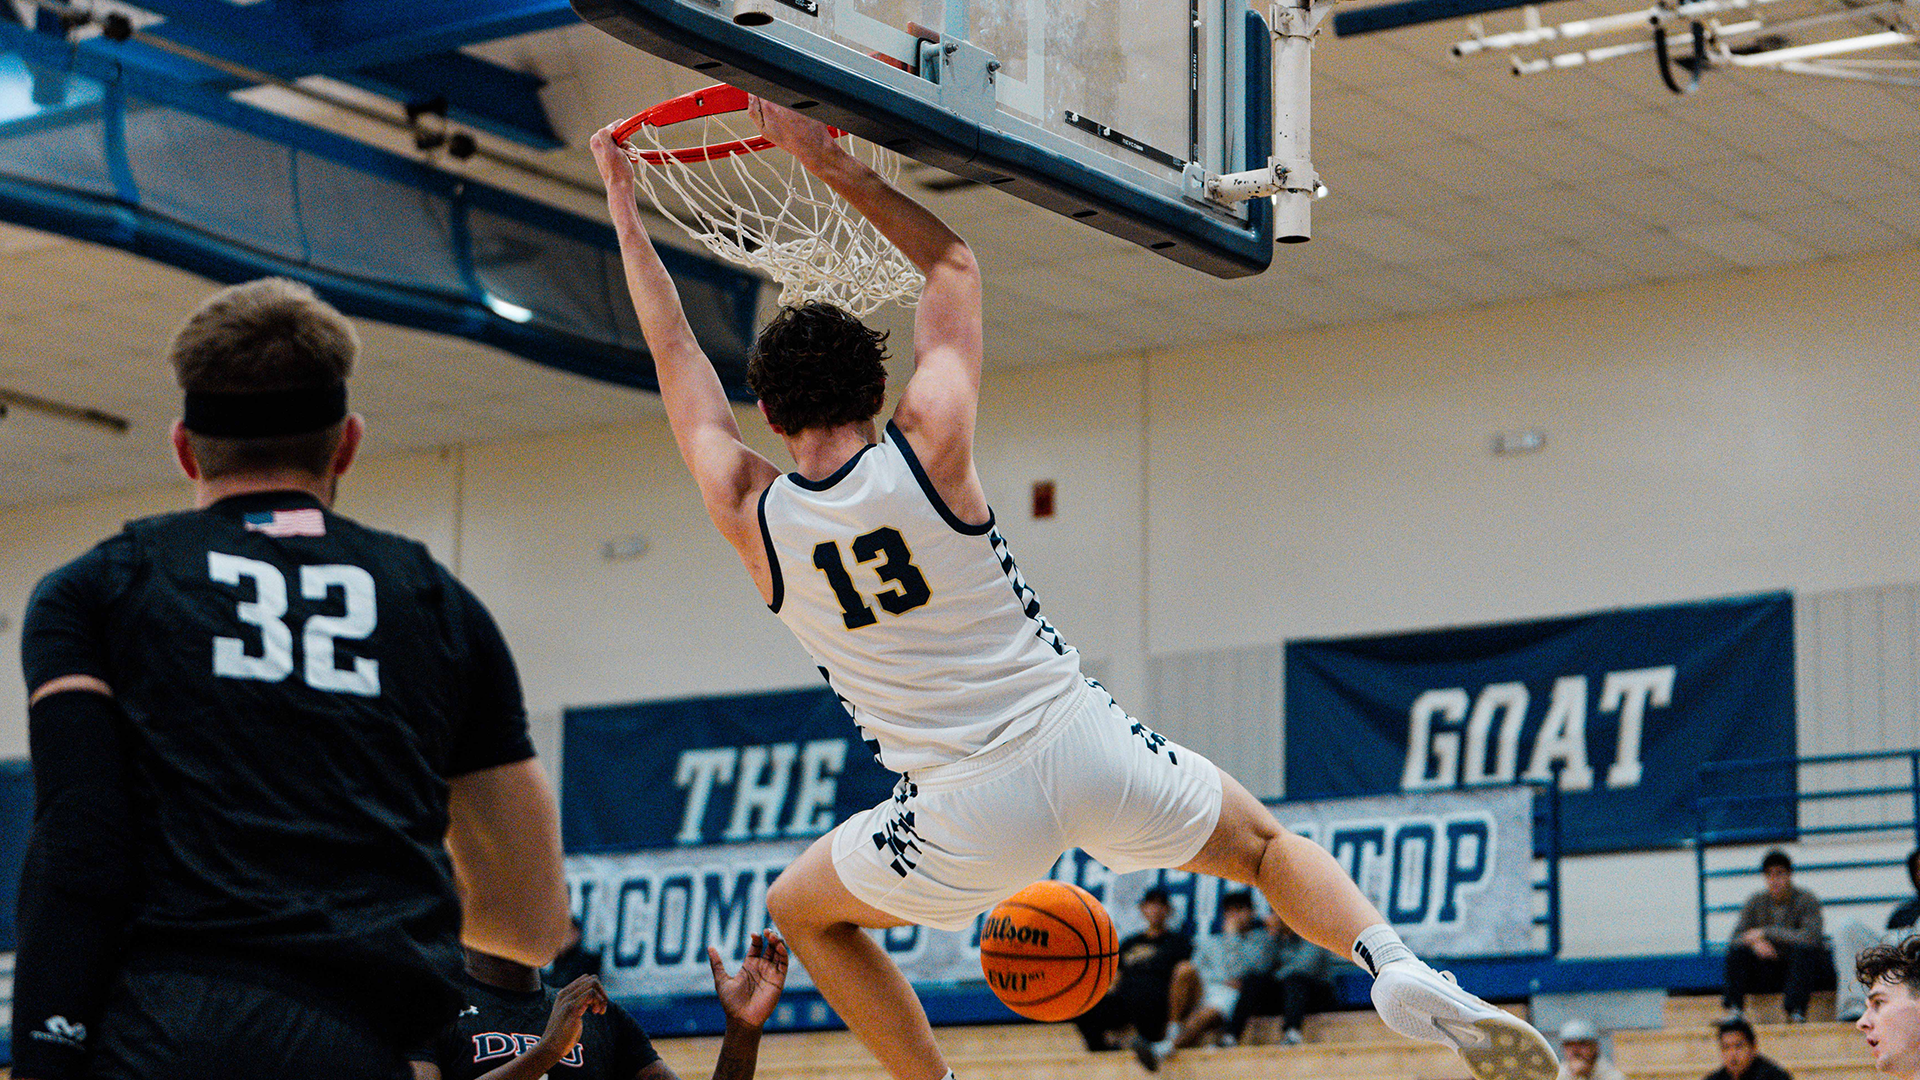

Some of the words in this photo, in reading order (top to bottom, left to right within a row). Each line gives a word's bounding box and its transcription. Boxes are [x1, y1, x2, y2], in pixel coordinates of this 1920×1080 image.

[207, 550, 381, 697] 32
[811, 524, 934, 632] 13
[1400, 664, 1677, 791] GOAT
[674, 737, 848, 843] THE
